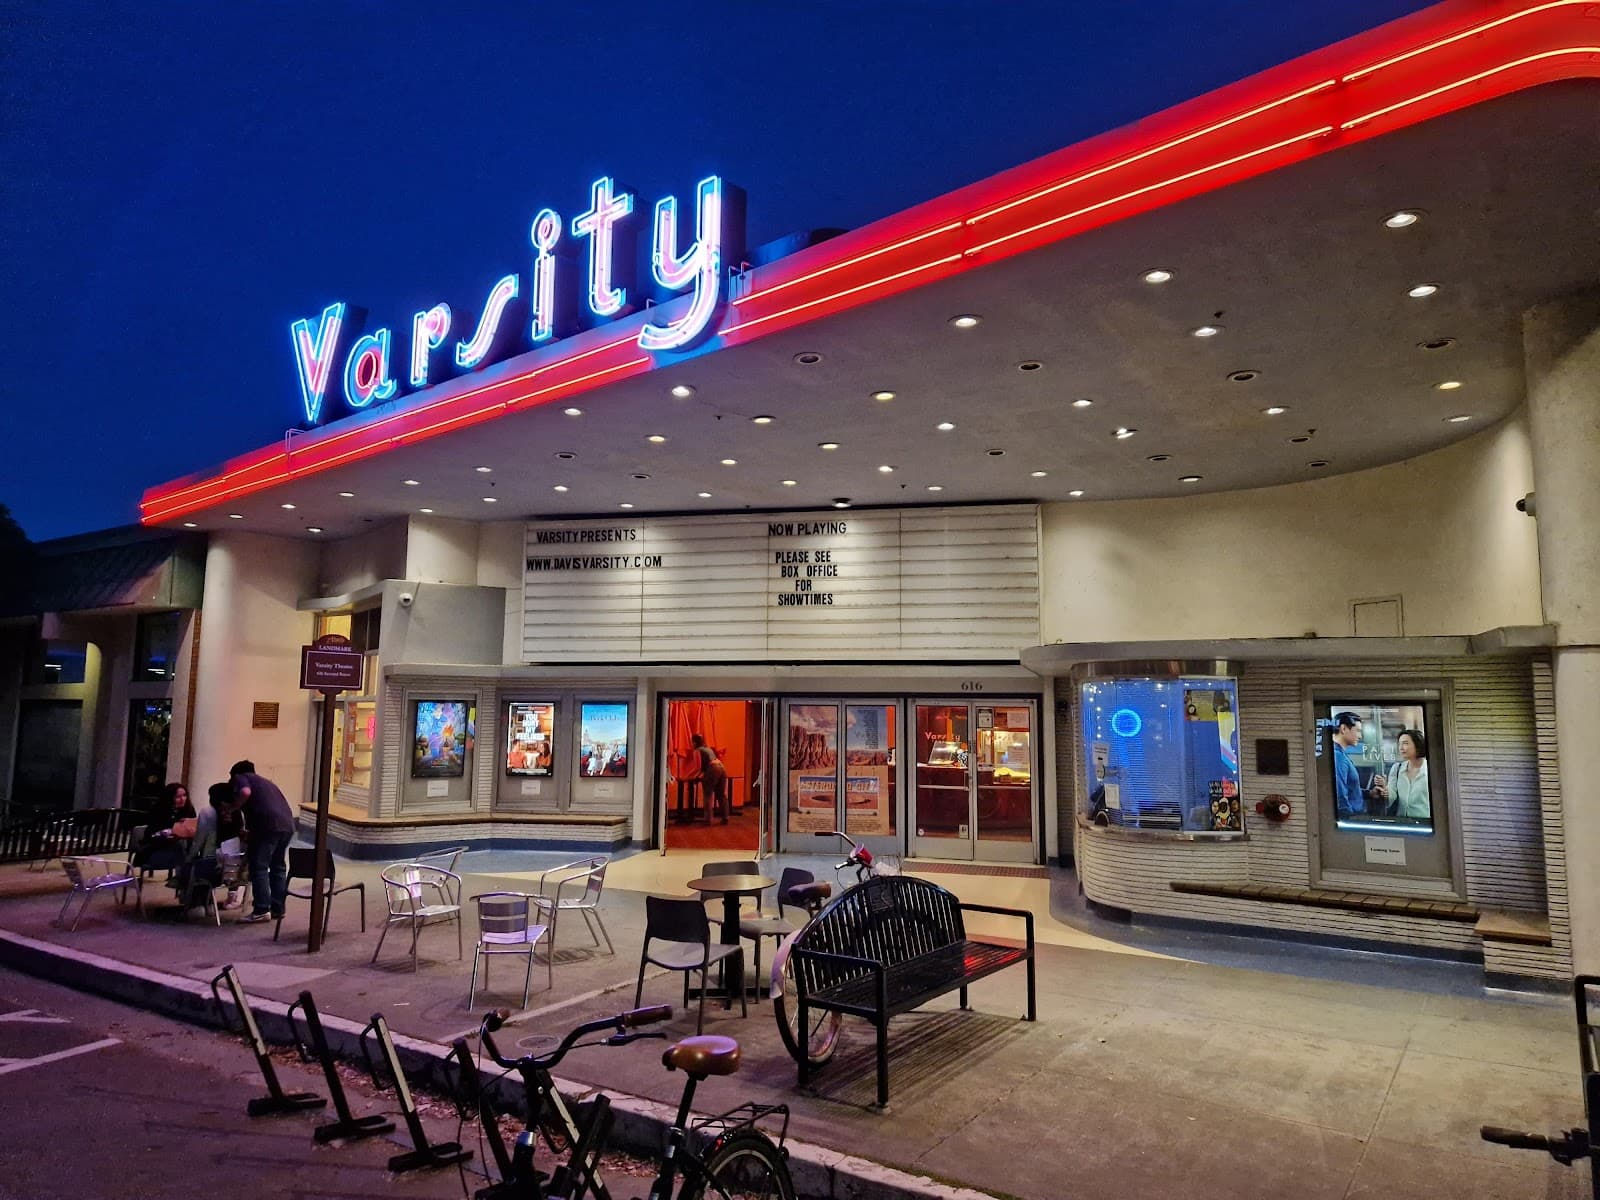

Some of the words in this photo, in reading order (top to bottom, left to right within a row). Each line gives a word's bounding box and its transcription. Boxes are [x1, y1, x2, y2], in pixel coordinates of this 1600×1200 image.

[290, 175, 723, 423] Varsity
[536, 530, 579, 543] VARSITY
[580, 528, 637, 542] PRESENTS
[768, 523, 794, 536] NOW
[797, 522, 847, 535] PLAYING
[775, 551, 809, 564] PLEASE
[814, 550, 831, 563] SEE
[781, 565, 799, 578] BOX
[806, 564, 838, 577] OFFICE
[795, 579, 812, 592] FOR
[778, 593, 833, 606] SHOWTIMES
[961, 681, 983, 691] 616
